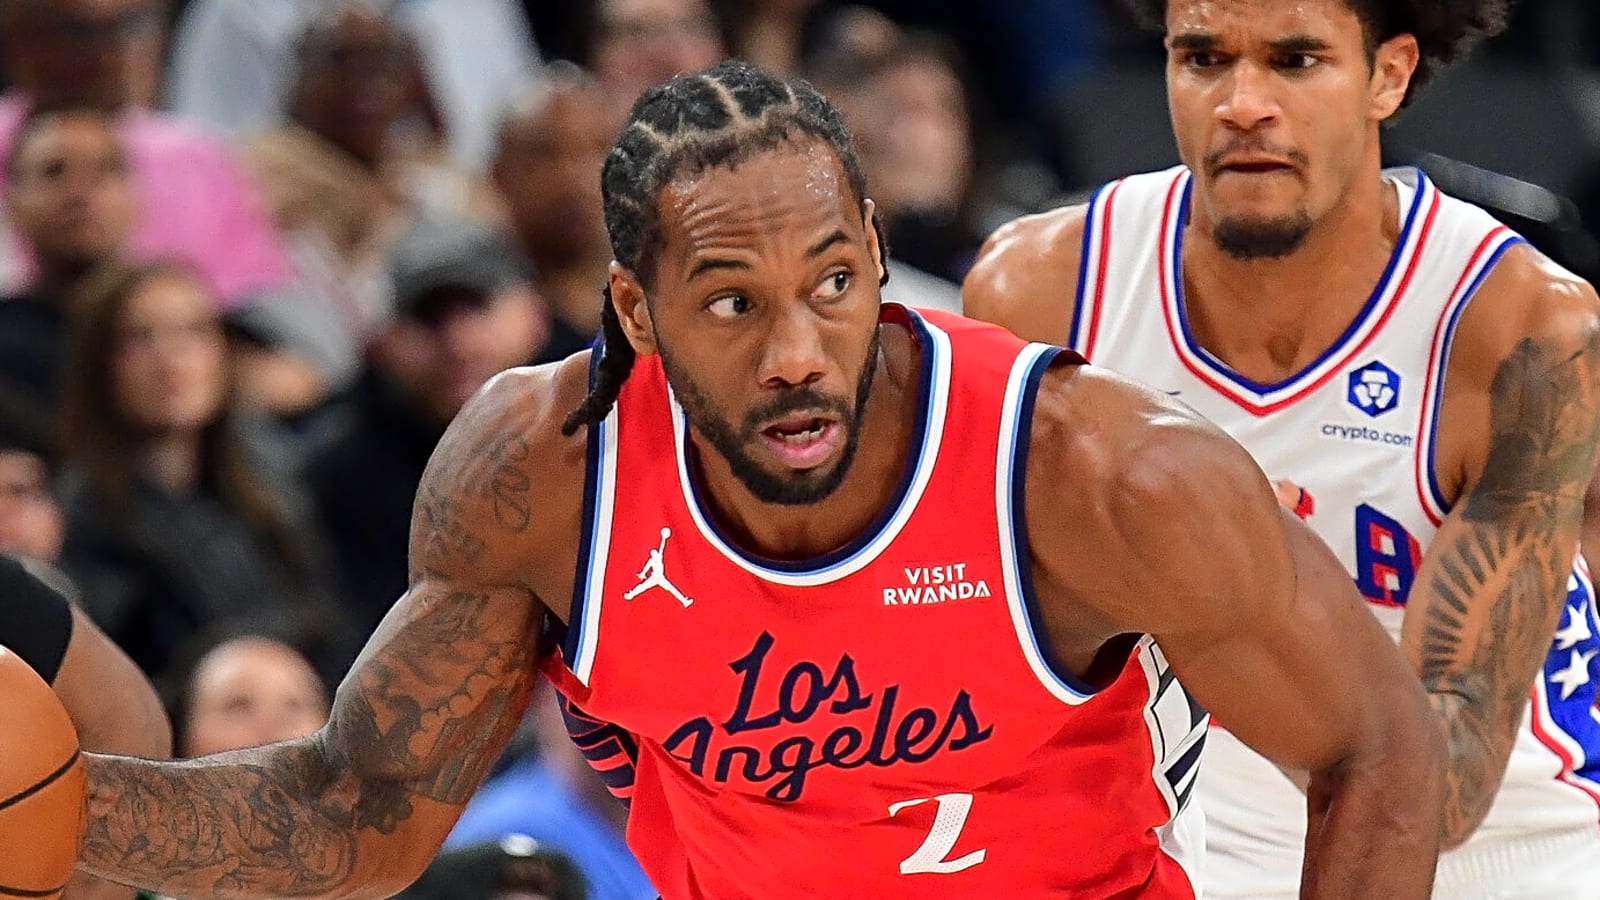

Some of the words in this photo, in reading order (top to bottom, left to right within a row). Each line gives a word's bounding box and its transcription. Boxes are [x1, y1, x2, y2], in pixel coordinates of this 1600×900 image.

[883, 580, 992, 605] RWANDA
[904, 563, 966, 585] VISIT
[723, 630, 873, 736] Los
[662, 684, 994, 802] Angeles
[888, 793, 987, 875] 2
